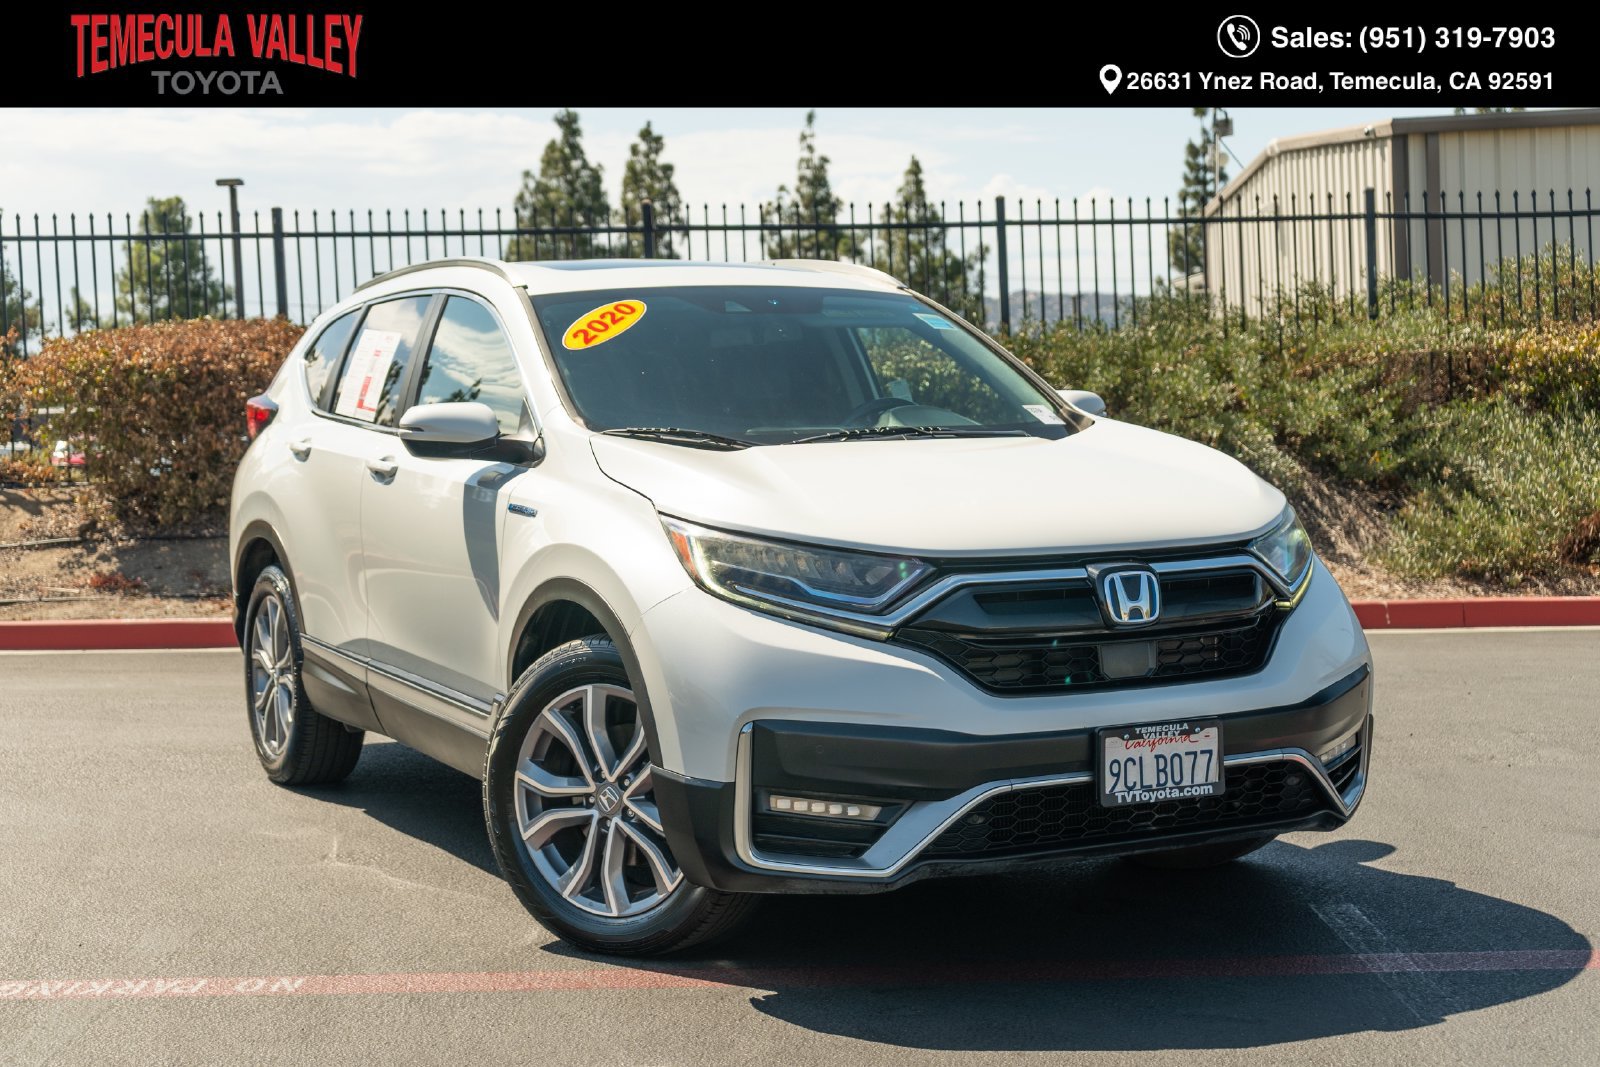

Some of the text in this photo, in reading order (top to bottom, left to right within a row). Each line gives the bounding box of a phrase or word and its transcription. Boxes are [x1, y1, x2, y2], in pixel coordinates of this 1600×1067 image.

[572, 303, 637, 346] 2020
[1135, 722, 1189, 735] TEMECULA
[1142, 730, 1180, 740] VALLEY
[1108, 749, 1213, 794] 9CLB077
[1115, 784, 1213, 804] TVToyota.com
[234, 976, 304, 994] NO
